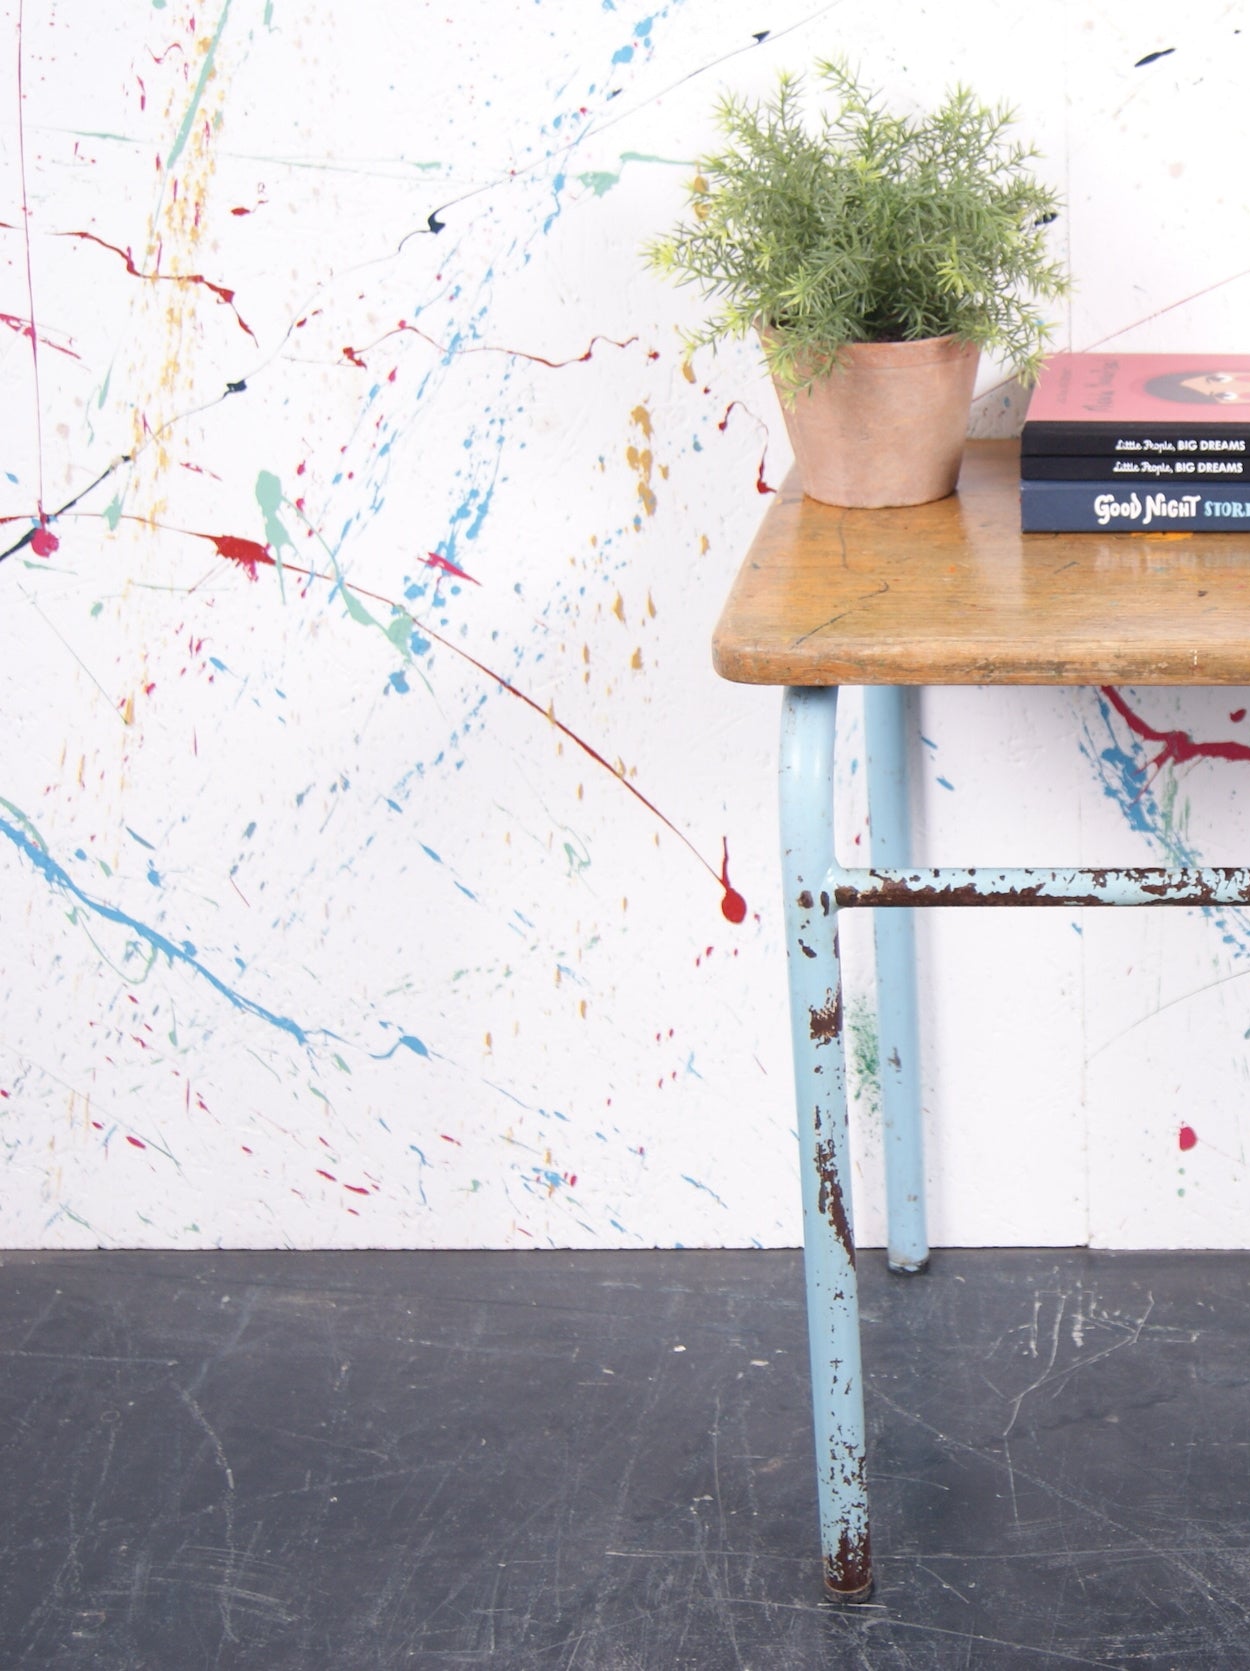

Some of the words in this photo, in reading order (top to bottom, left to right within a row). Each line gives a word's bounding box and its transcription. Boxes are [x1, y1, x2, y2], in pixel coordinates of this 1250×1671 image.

[1115, 439, 1142, 451] Little
[1143, 439, 1176, 453] People,
[1177, 440, 1198, 451] BIG
[1200, 440, 1246, 451] DREAMS
[1113, 461, 1139, 472] Little
[1140, 461, 1173, 476] People,
[1175, 462, 1195, 473] BIG
[1197, 462, 1243, 473] DREAMS
